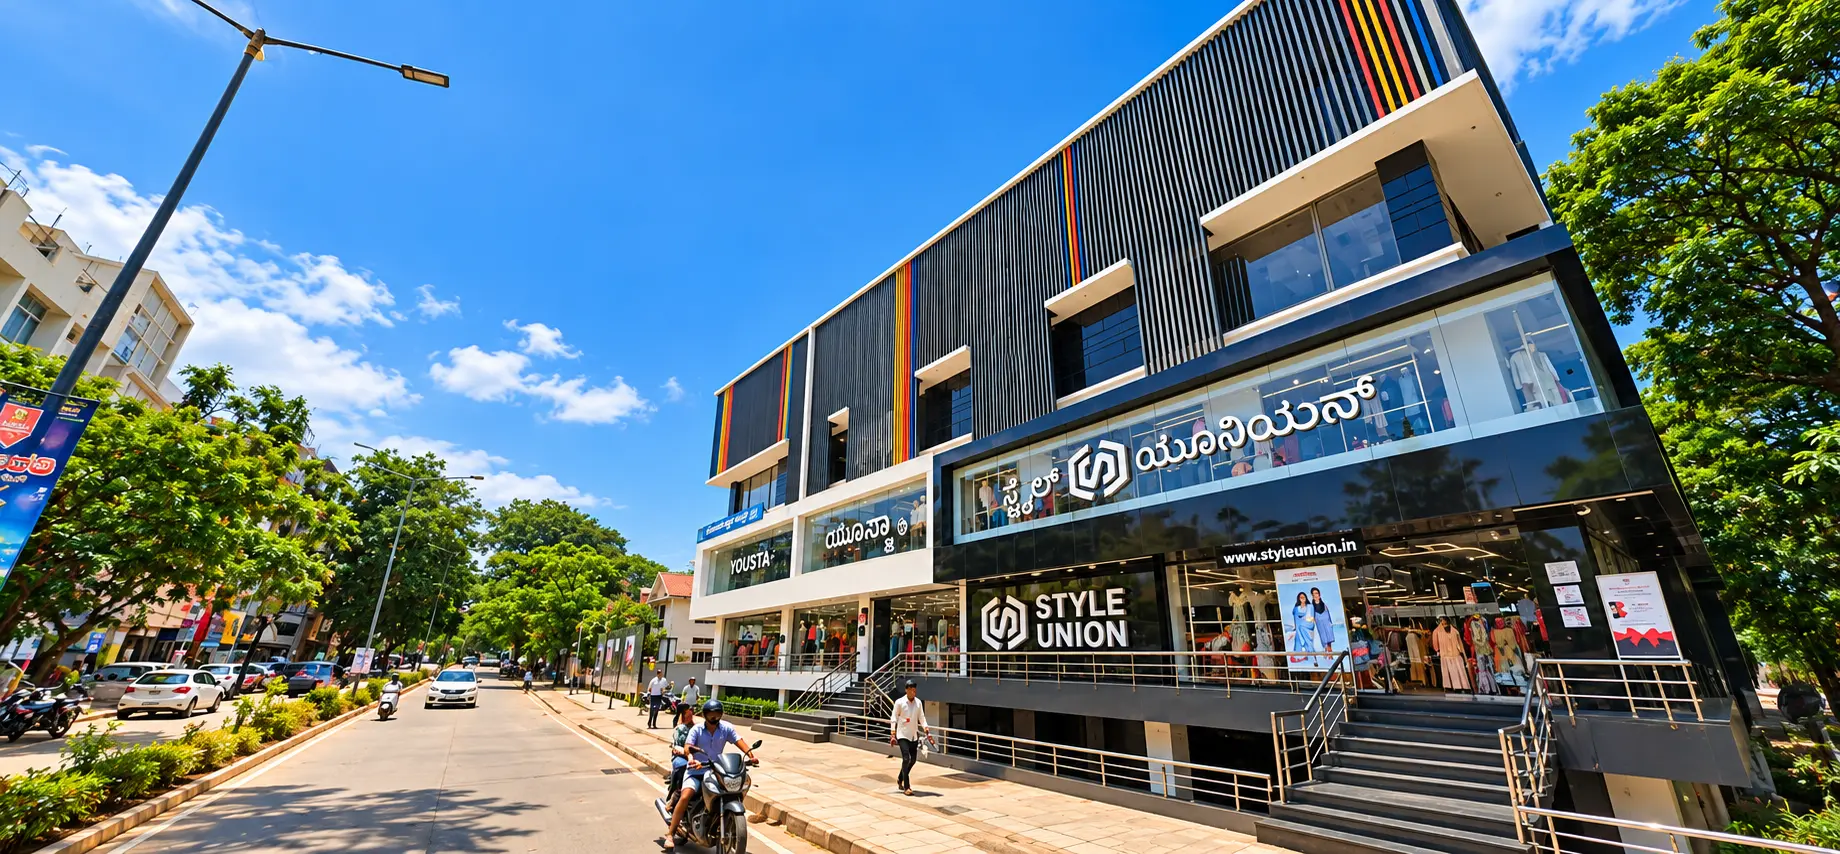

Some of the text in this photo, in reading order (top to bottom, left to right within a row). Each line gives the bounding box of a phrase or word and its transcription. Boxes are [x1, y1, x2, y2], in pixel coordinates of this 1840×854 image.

[1002, 374, 1377, 519] ಸ್ಟೈಲ್ ಯೂನಿಯನ್
[730, 550, 770, 575] YOUSTA
[1223, 539, 1357, 564] www.styleunion.in
[1035, 587, 1126, 618] STYLE
[1036, 620, 1129, 648] UNION
